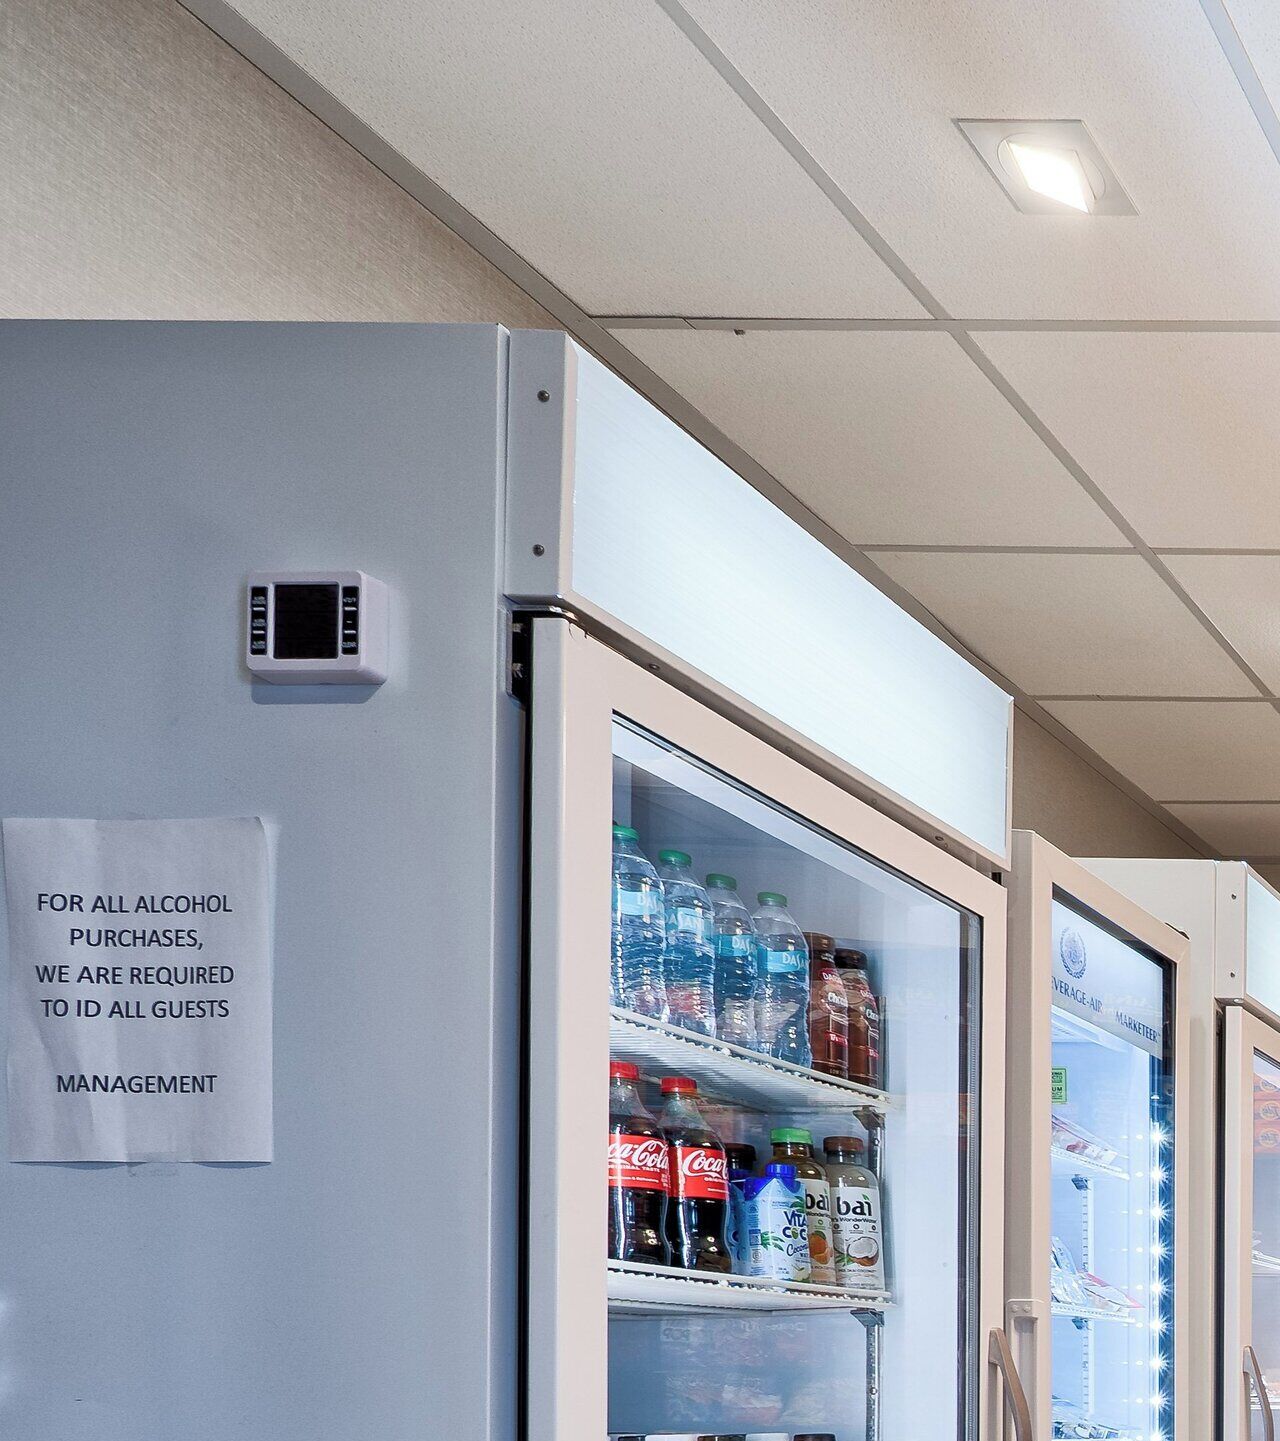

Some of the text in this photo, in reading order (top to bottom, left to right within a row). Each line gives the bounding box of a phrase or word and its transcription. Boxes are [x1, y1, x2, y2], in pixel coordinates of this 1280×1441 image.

[37, 893, 232, 914] FOR ALL ALCOHOL
[69, 928, 204, 951] PURCHASES,
[35, 965, 234, 986] WE ARE REQUIRED
[1052, 976, 1103, 1014] VERAGE-AIR
[40, 999, 229, 1019] TO ID ALL GUESTS
[56, 1074, 218, 1094] MANAGEMENT
[608, 1140, 668, 1169] ca-Cola
[836, 1194, 872, 1217] bai
